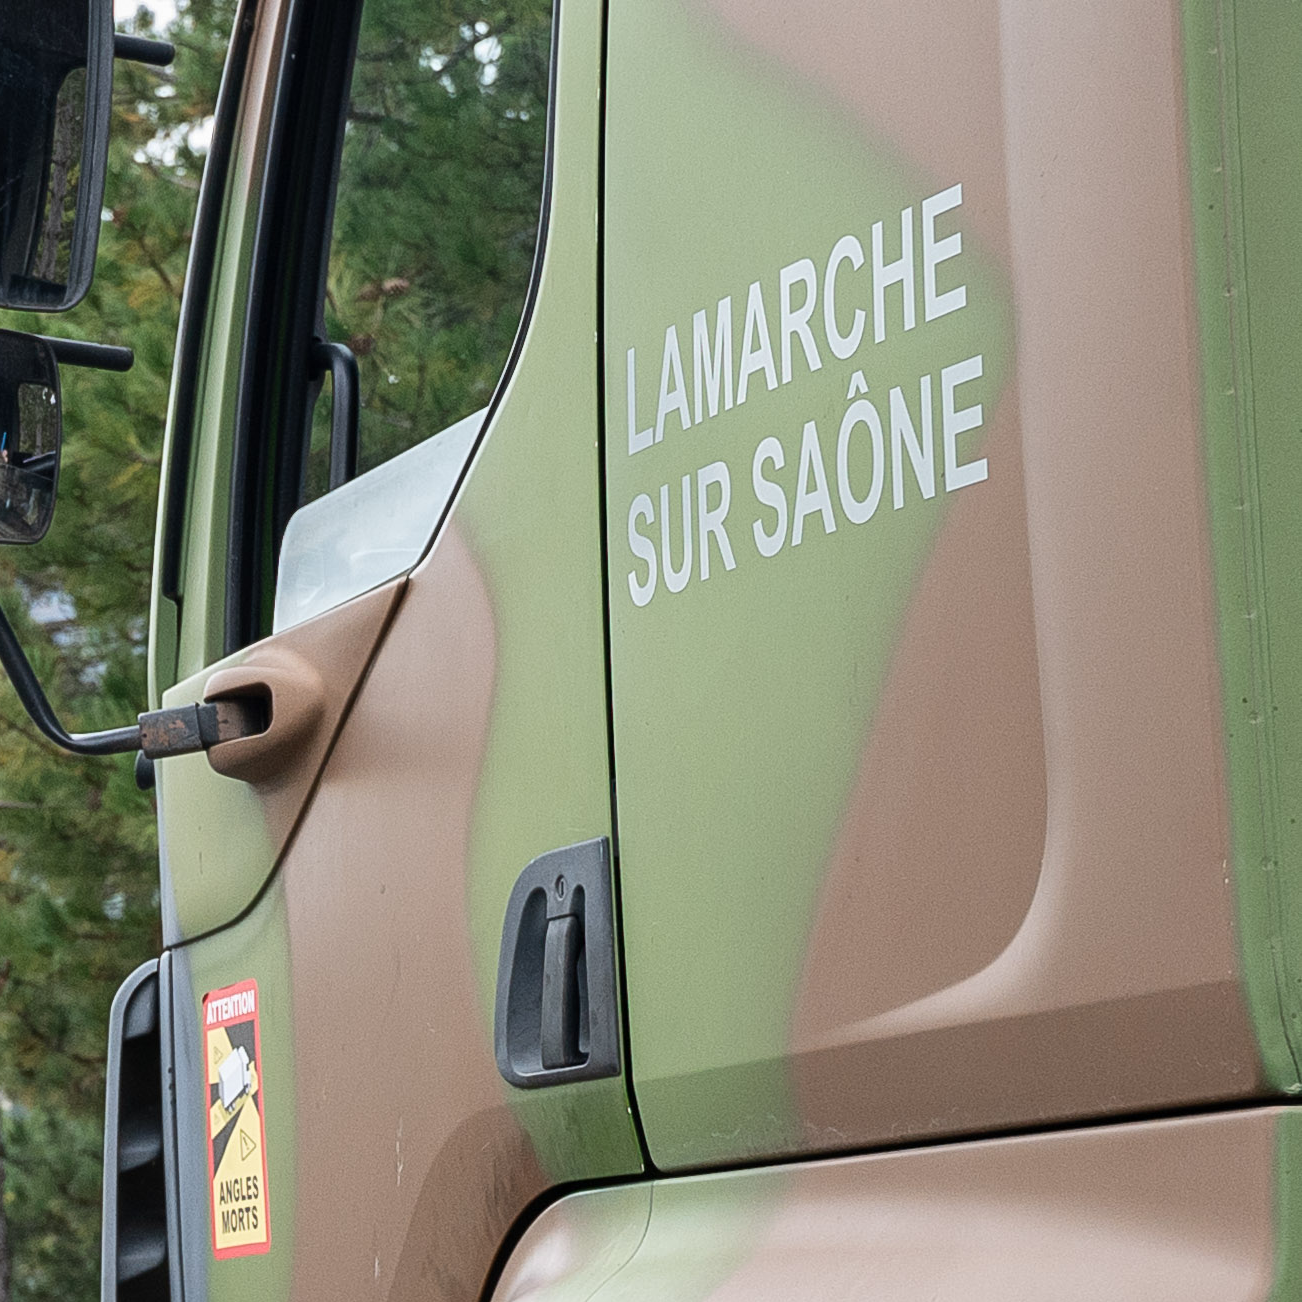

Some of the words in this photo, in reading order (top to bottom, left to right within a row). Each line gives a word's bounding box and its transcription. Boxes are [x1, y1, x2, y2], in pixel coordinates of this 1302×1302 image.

[626, 182, 967, 457] LAMARCHE
[627, 460, 737, 608] SUR
[752, 354, 989, 559] SAÔNE
[206, 989, 255, 1025] ATTENTION
[219, 1175, 260, 1206] ANGLES
[221, 1205, 259, 1235] MORTS
